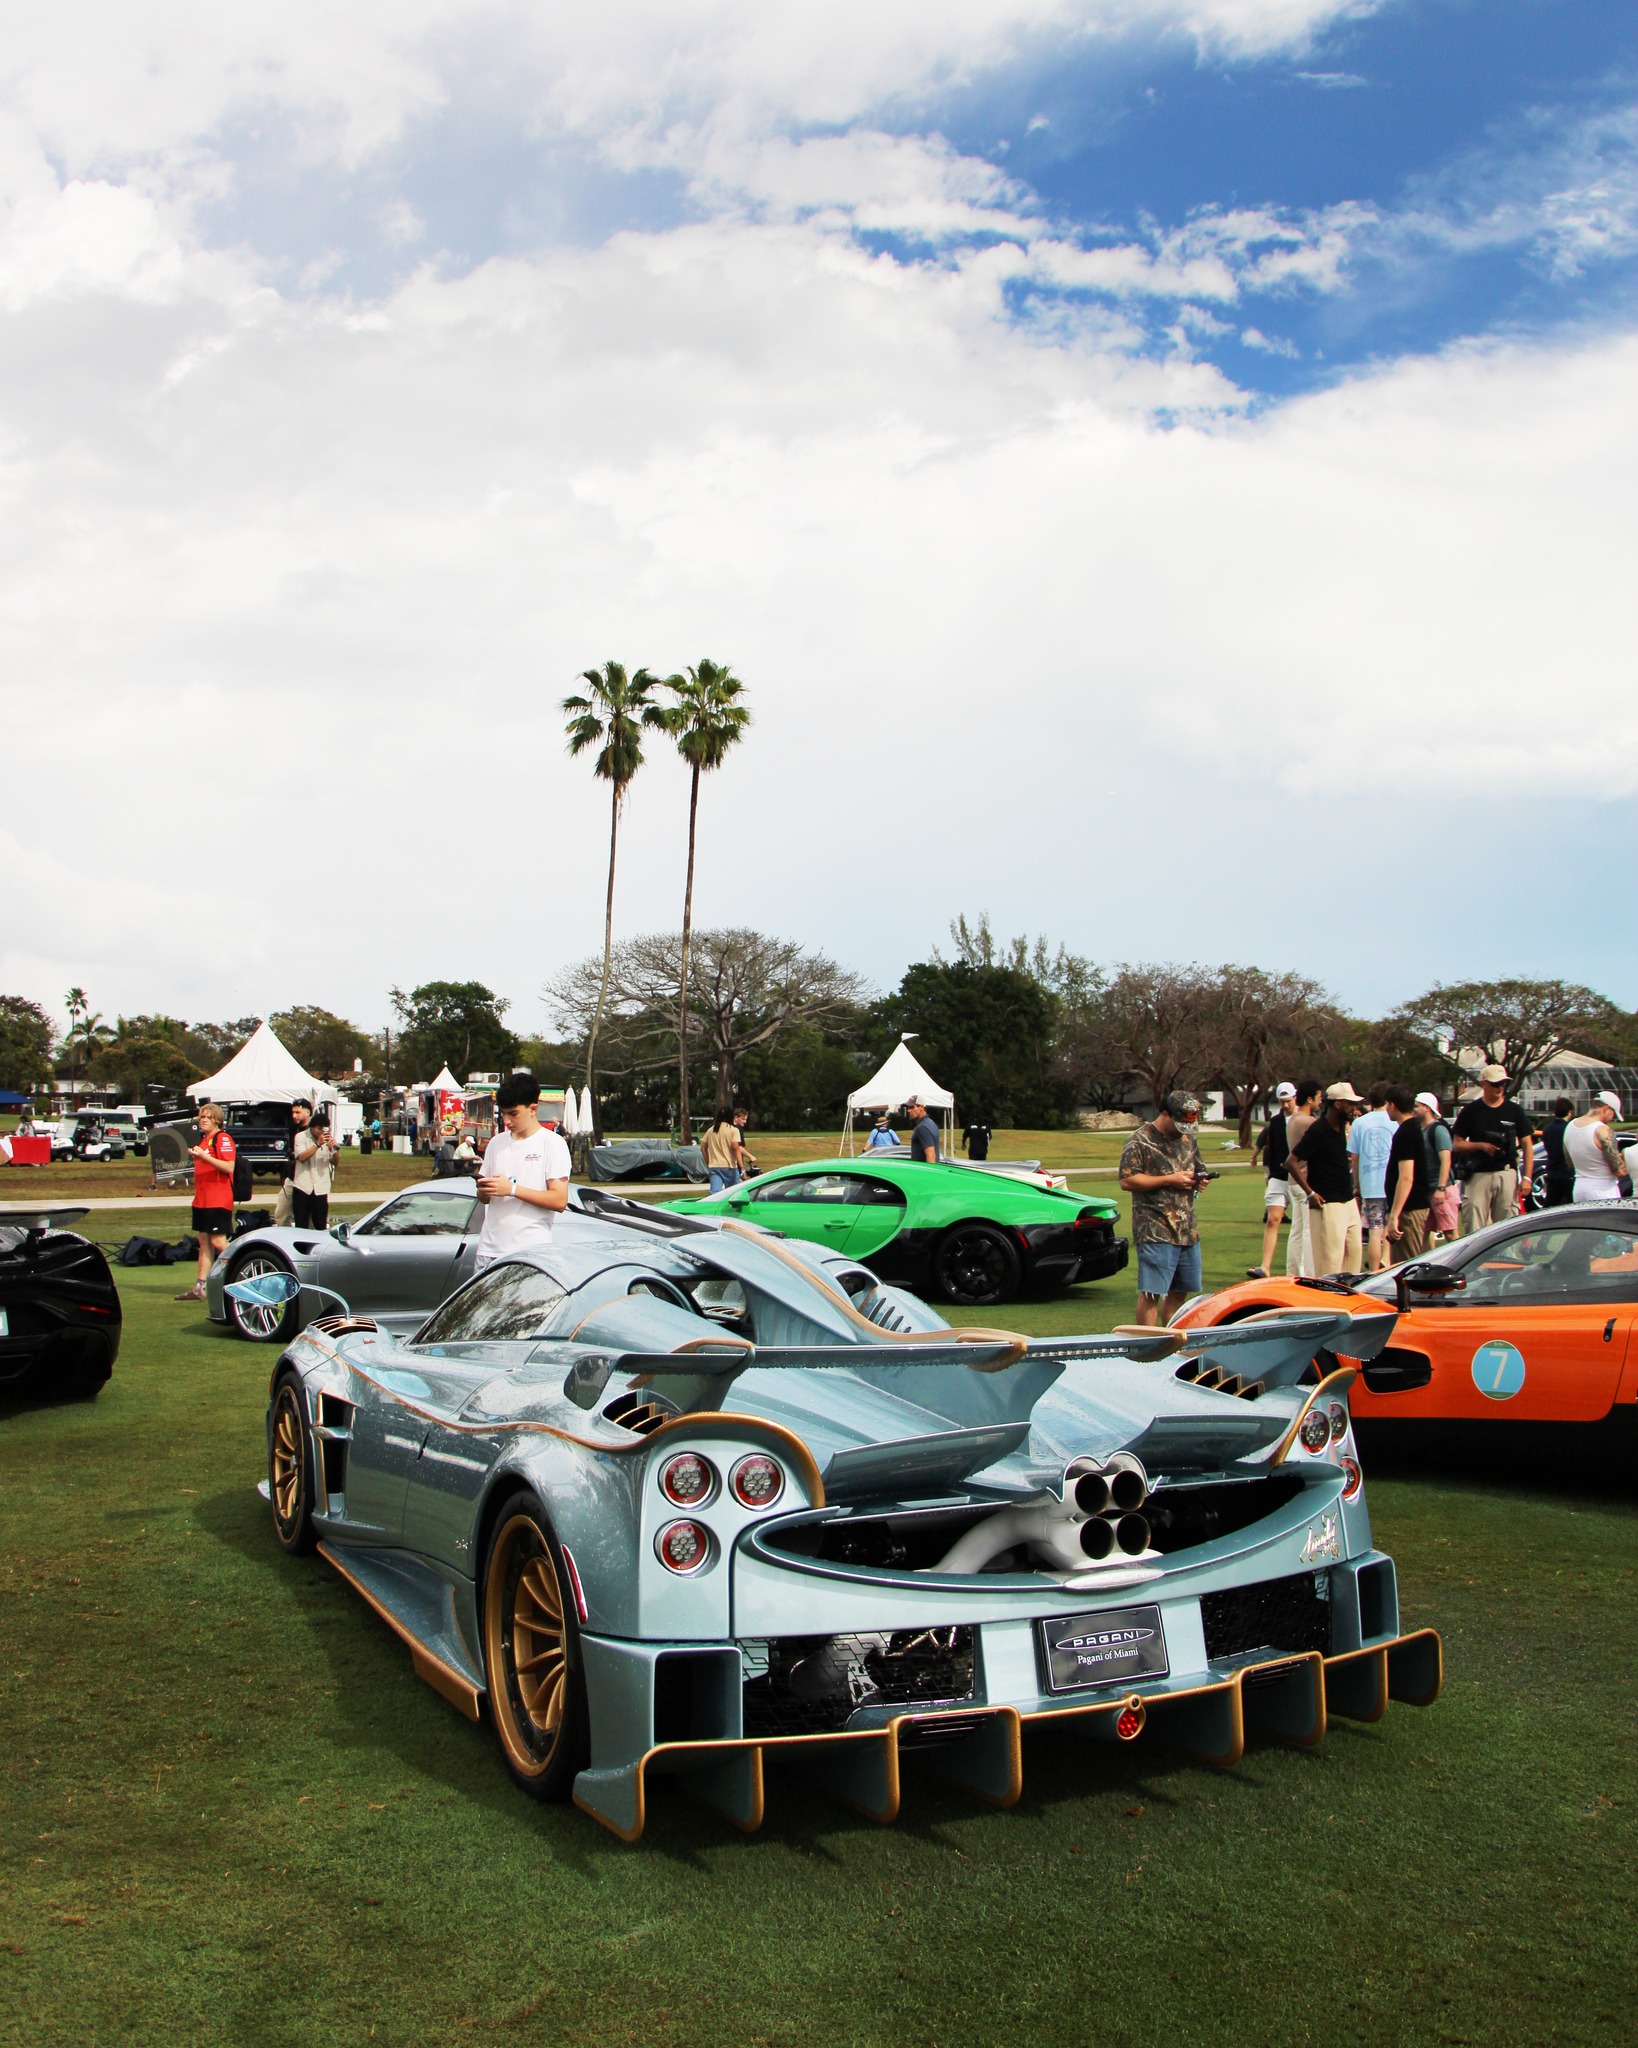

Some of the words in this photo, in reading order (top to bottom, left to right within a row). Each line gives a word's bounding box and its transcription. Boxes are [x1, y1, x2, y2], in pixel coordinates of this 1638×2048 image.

[1490, 1351, 1508, 1389] 7
[1073, 1630, 1139, 1648] PAGANI
[1077, 1652, 1103, 1666] Pagani
[1104, 1650, 1113, 1660] of
[1114, 1646, 1139, 1659] Miami
